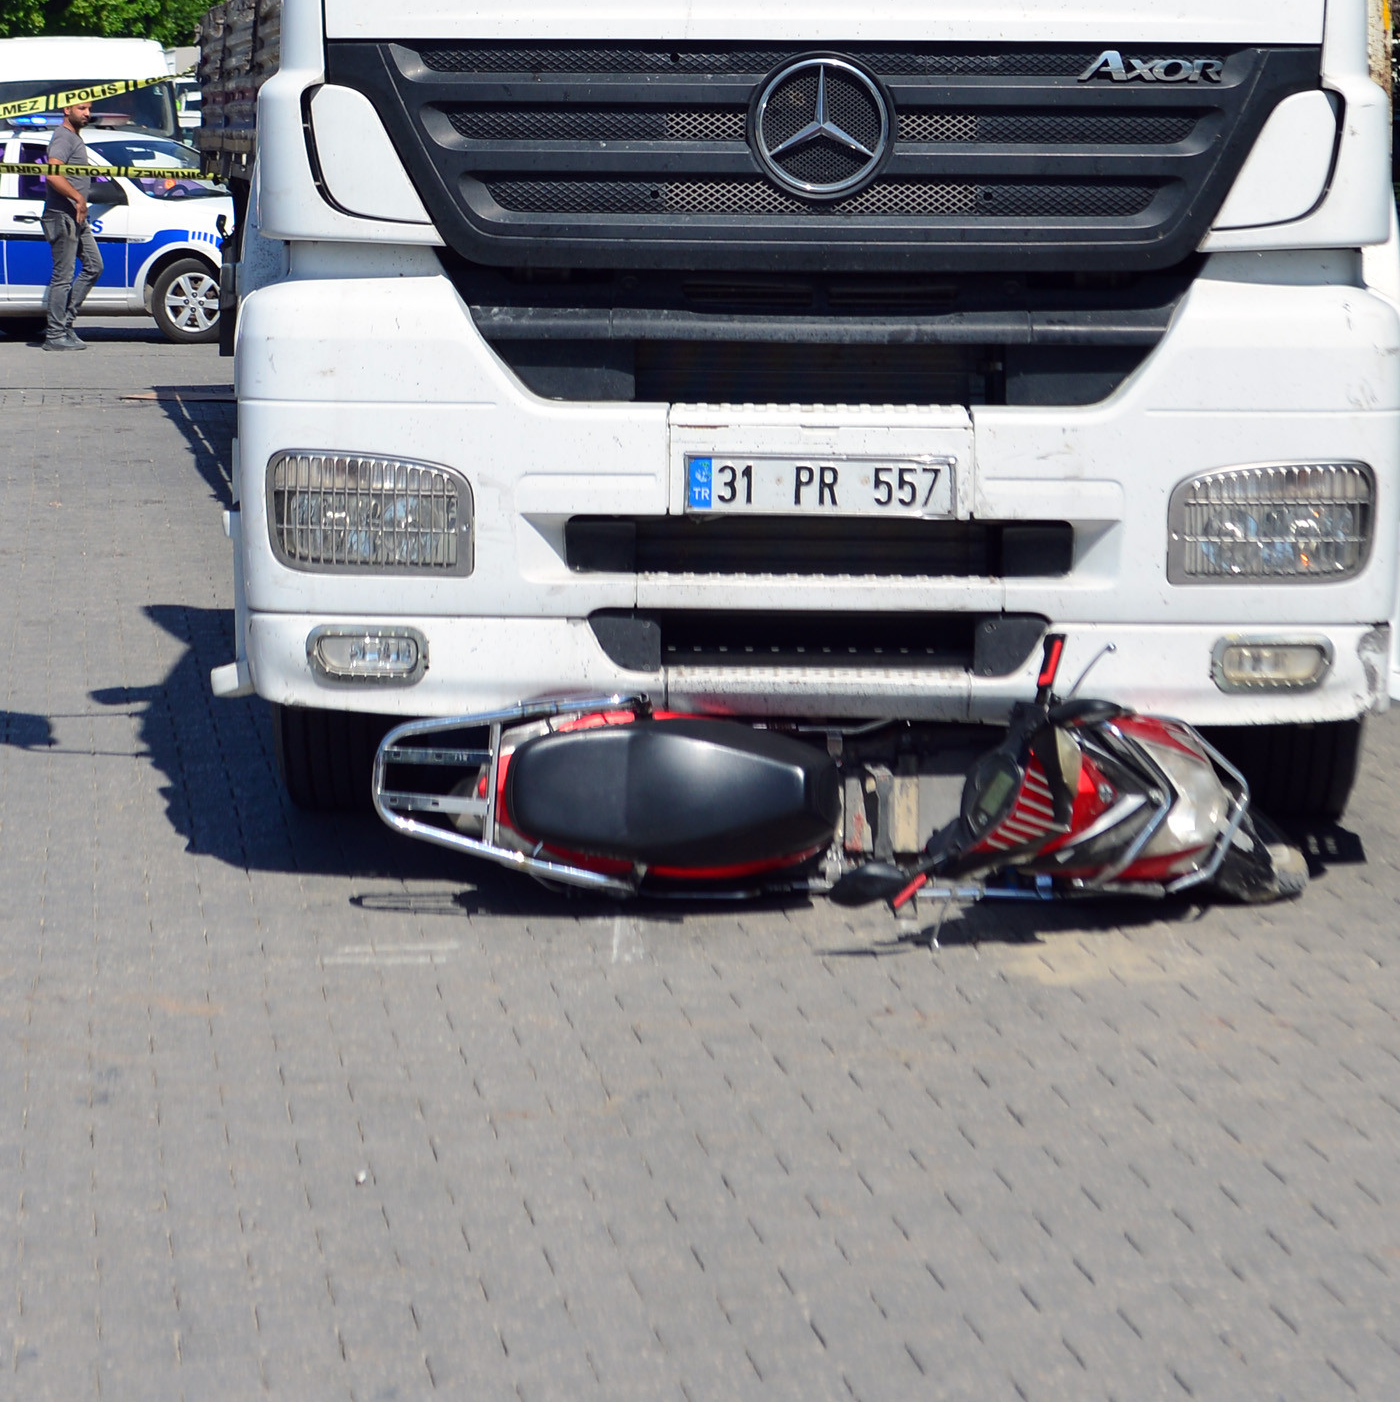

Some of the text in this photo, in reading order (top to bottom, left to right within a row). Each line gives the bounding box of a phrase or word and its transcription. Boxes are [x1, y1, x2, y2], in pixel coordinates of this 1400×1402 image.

[693, 465, 942, 507] TR 31 PR 557
